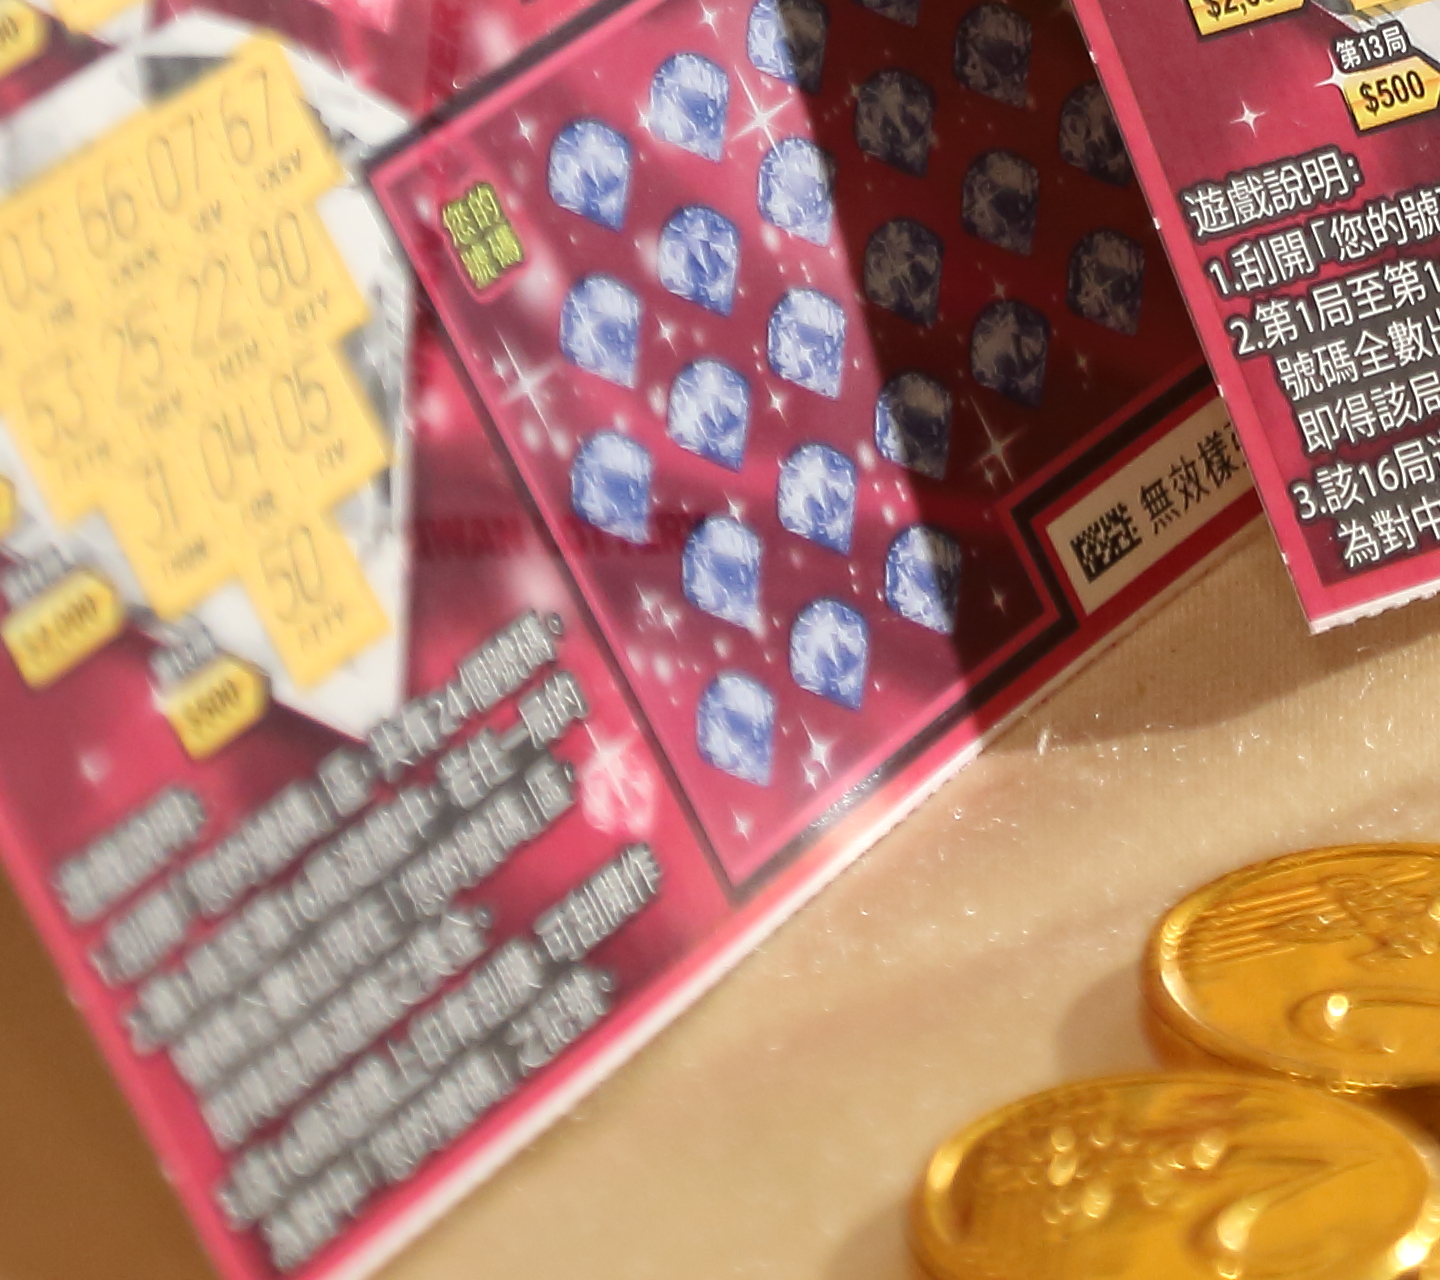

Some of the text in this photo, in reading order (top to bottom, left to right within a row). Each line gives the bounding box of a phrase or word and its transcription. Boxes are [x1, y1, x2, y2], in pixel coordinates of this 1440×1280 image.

[1357, 67, 1427, 112] $500
[1185, 152, 1362, 239] 遊戲說明:
